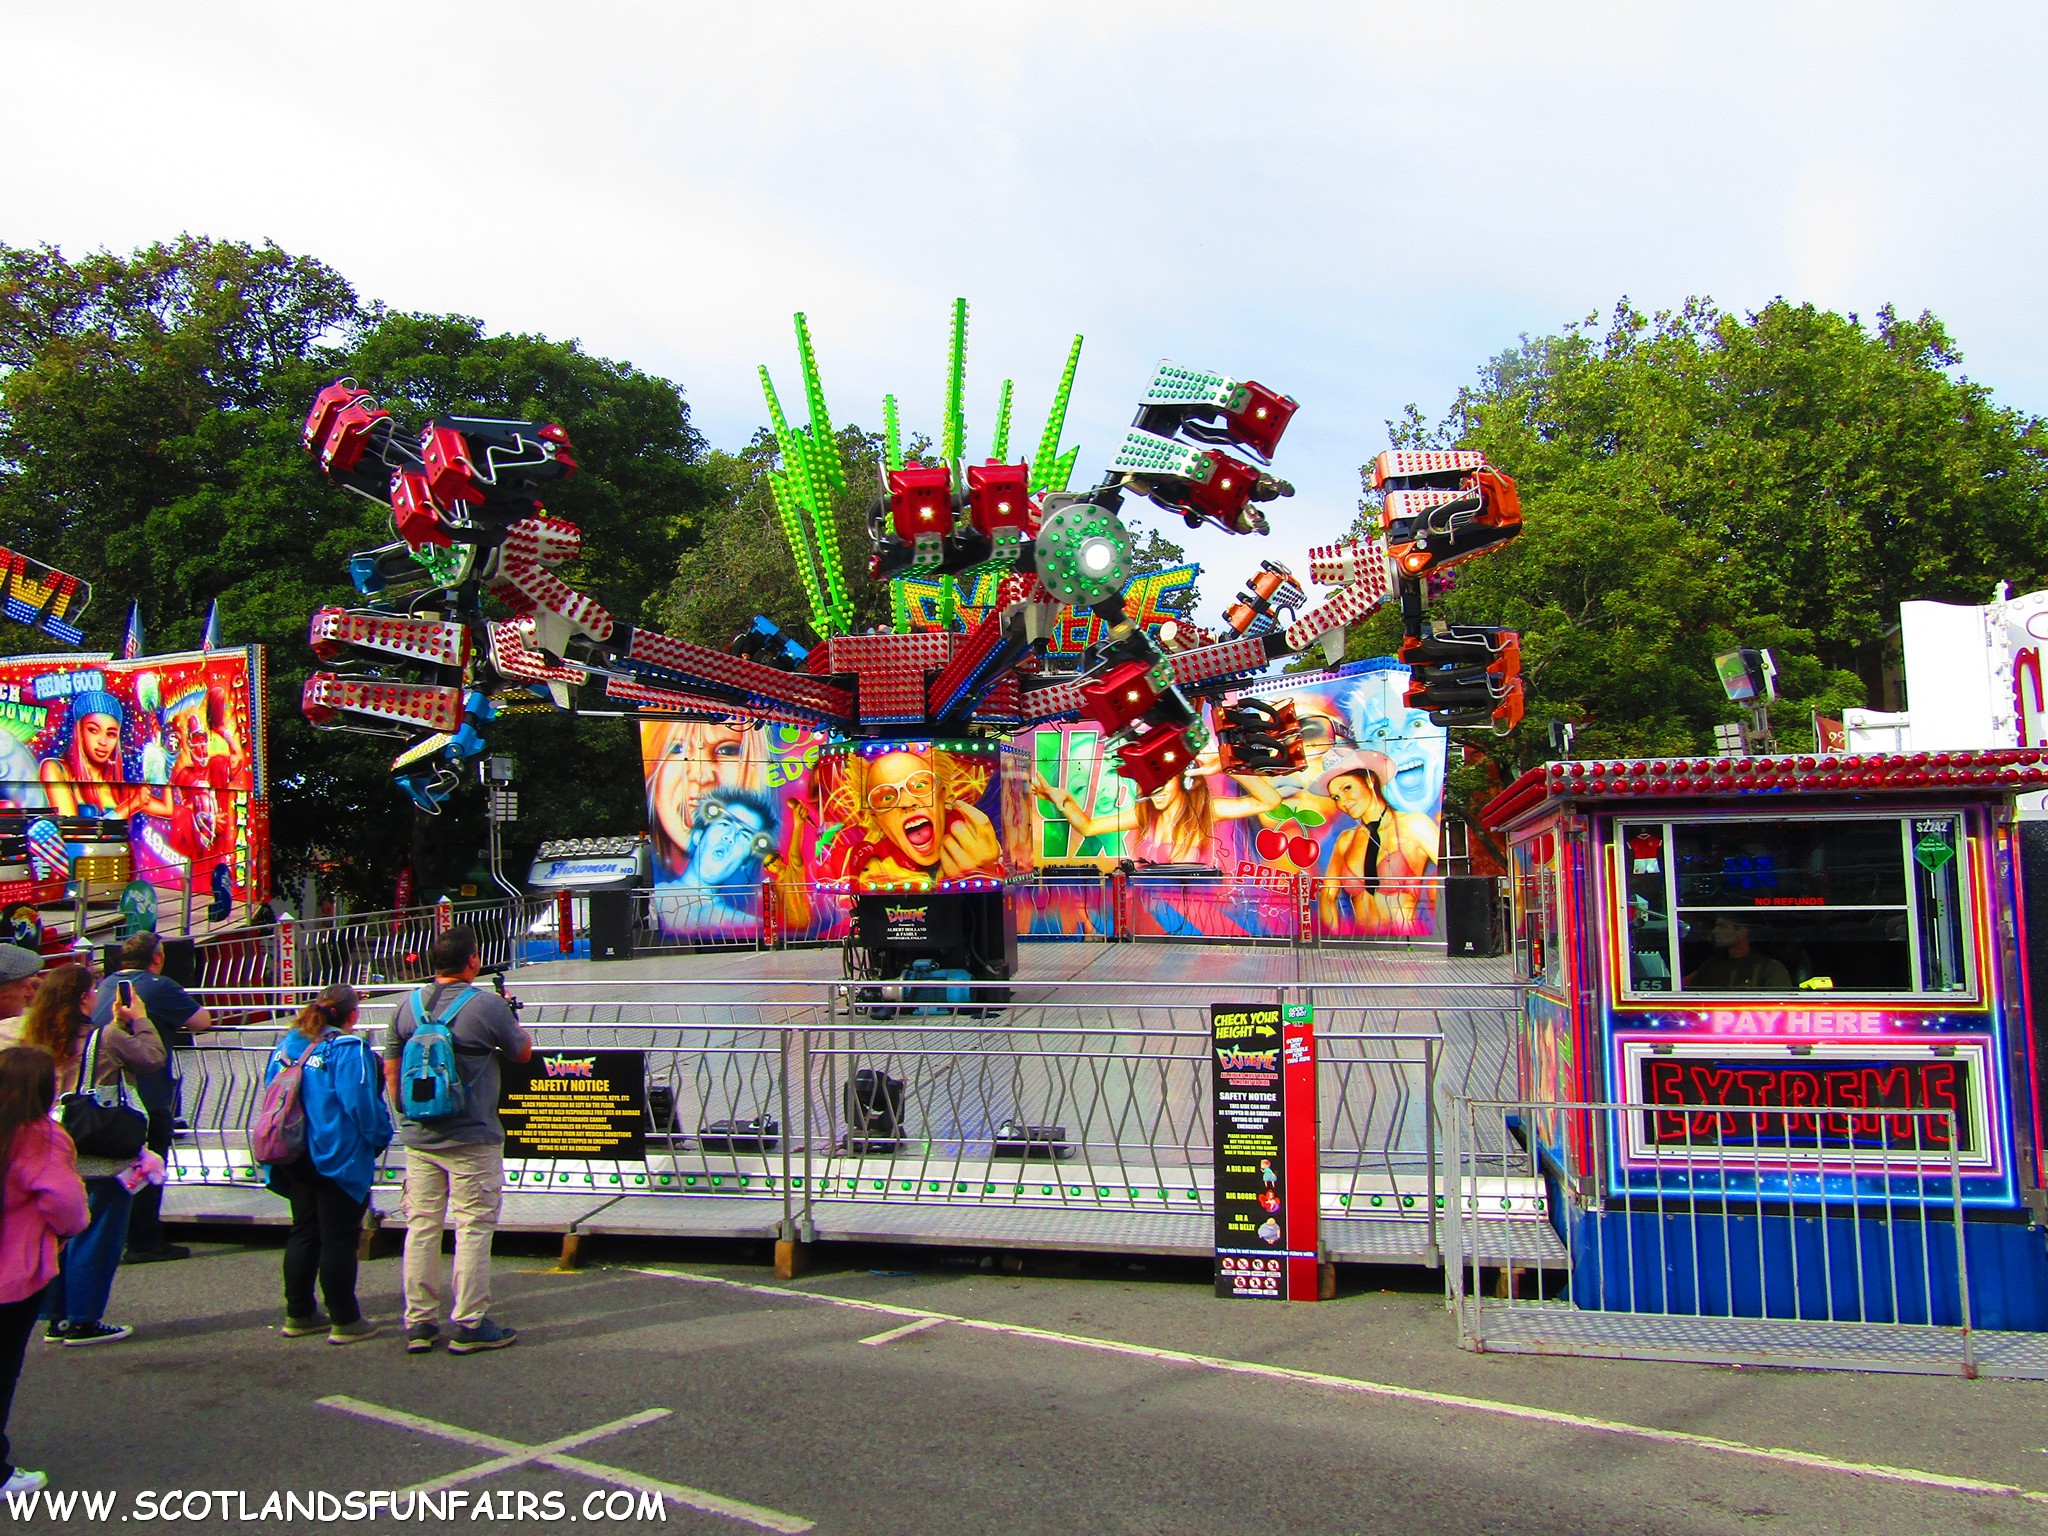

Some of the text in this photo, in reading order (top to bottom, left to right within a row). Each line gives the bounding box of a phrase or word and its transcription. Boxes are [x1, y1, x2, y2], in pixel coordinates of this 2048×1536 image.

[36, 670, 103, 699] FEELING GOOD
[232, 674, 248, 745] GIANTS
[1916, 822, 1948, 832] S2242
[236, 790, 248, 888] BEARS
[545, 861, 618, 879] Showmen
[1301, 877, 1311, 941] EXTREME
[1214, 1013, 1248, 1026] CHECK
[1250, 1011, 1279, 1024] YOUR
[1714, 1012, 1880, 1033] PAY HERE
[1216, 1025, 1254, 1039] HEIGHT
[542, 1053, 597, 1077] EXTREME
[1216, 1044, 1280, 1070] EXTREME
[530, 1080, 610, 1092] SAFETY NOTICE
[1219, 1092, 1277, 1101] SAFETY NOTICE
[1652, 1062, 1957, 1142] EXTREME
